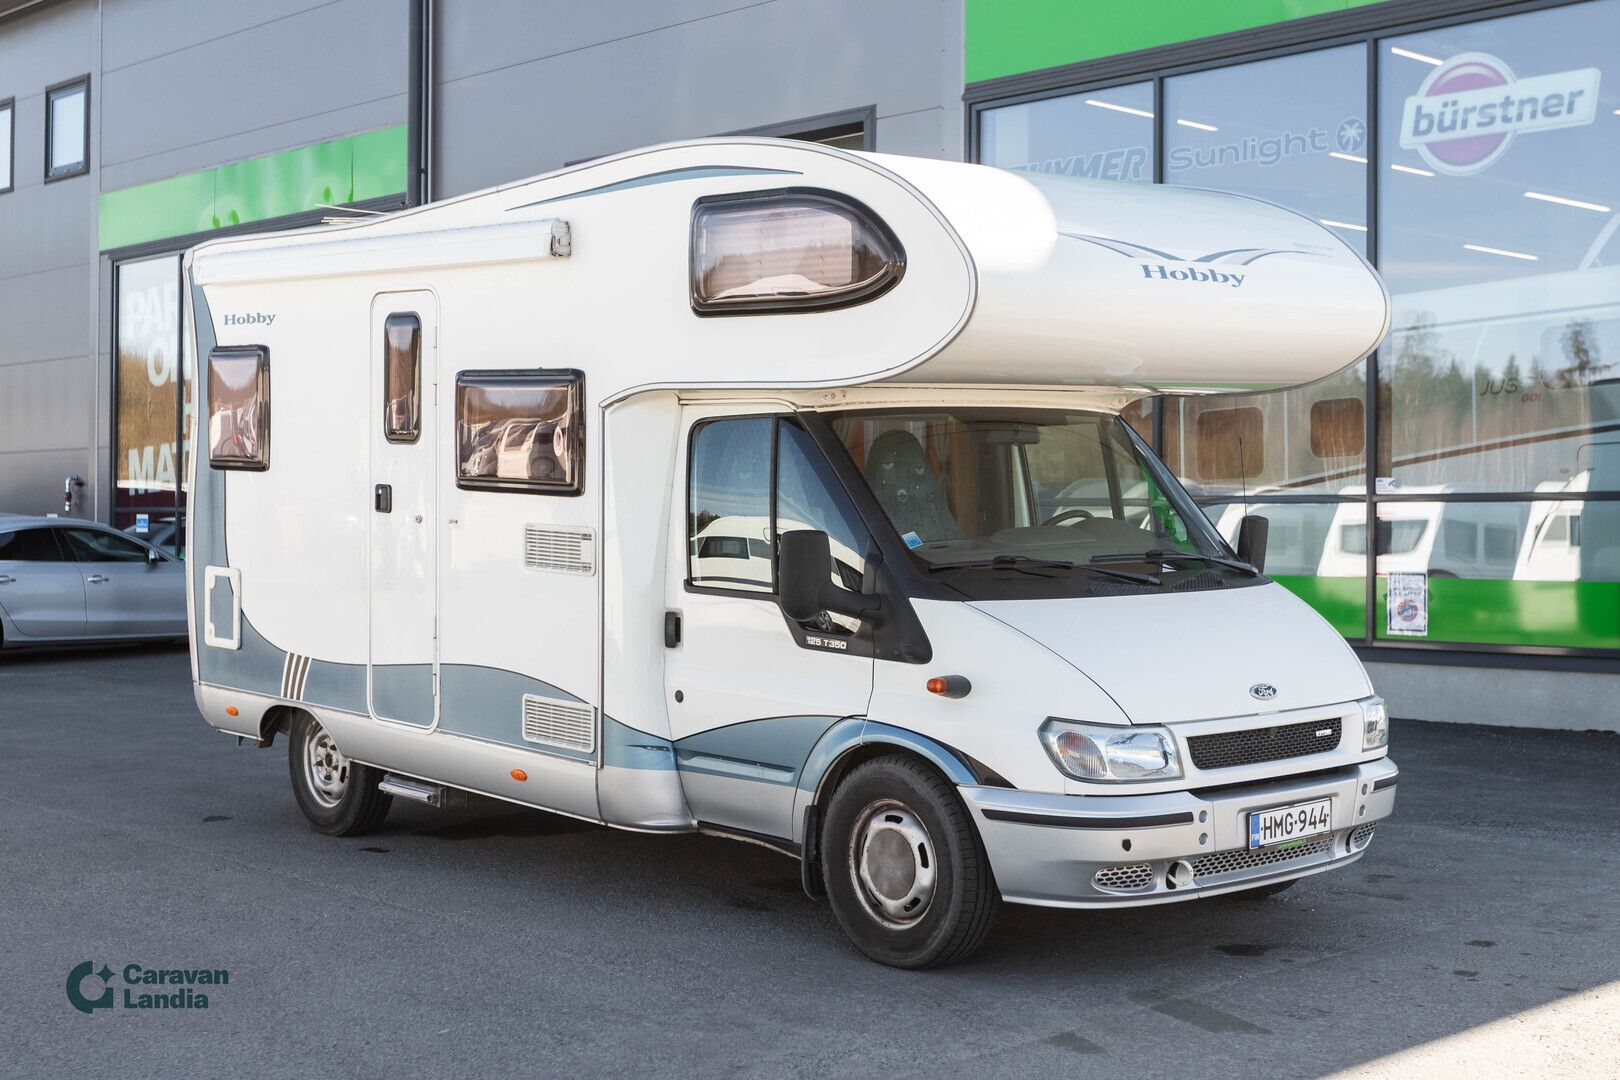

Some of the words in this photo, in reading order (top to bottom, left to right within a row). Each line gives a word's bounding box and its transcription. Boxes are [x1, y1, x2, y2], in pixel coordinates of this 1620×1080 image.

[1412, 89, 1585, 137] bürstner
[1168, 128, 1328, 171] Sunlight
[1141, 264, 1246, 288] Hobby
[223, 312, 276, 326] Hobby
[806, 636, 822, 646] 125
[823, 639, 847, 650] T350
[1263, 805, 1328, 840] HMG-944
